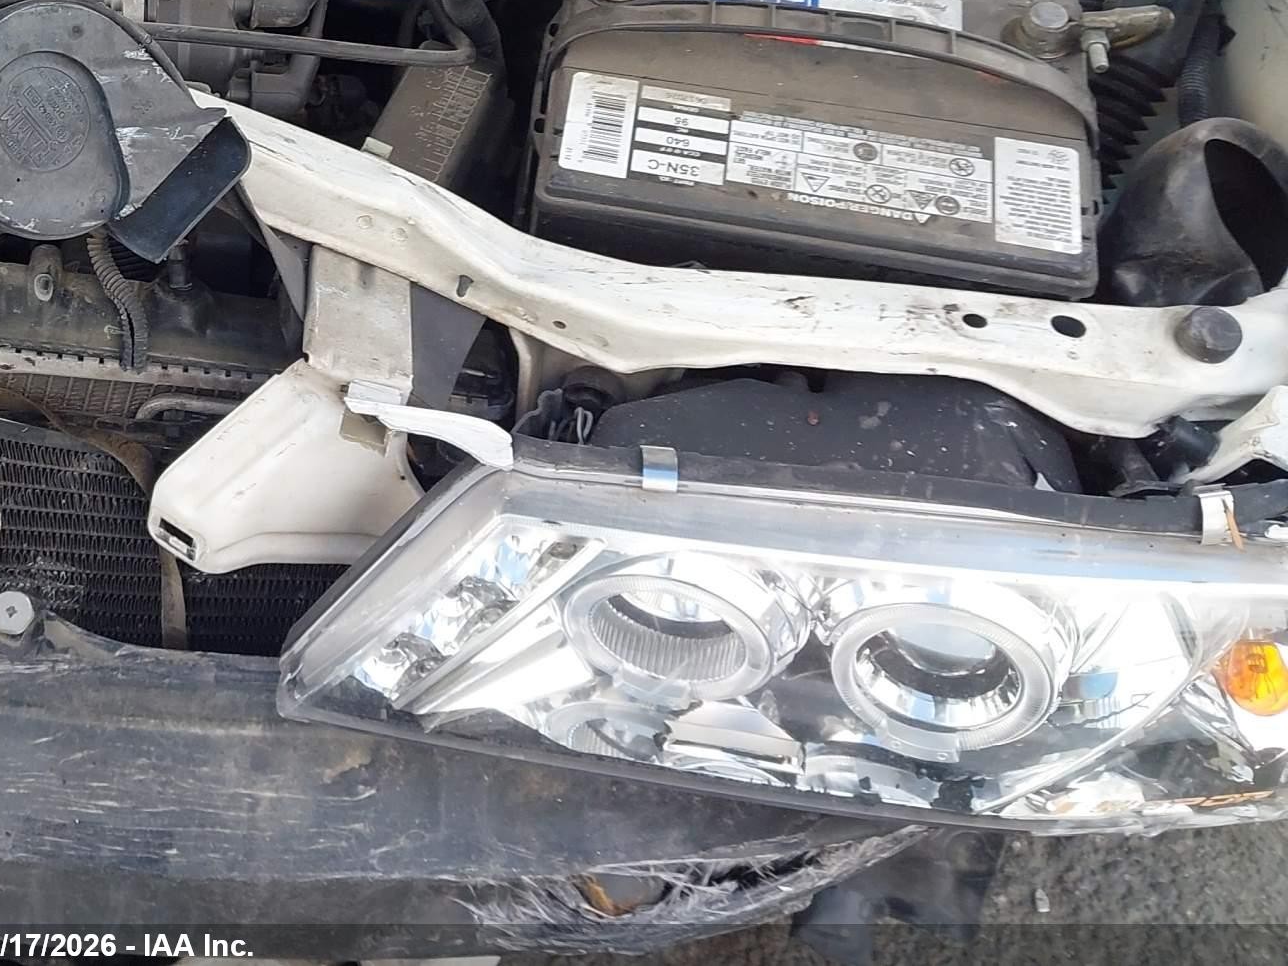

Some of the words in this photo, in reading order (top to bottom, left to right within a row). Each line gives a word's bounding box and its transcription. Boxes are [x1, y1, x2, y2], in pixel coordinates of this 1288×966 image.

[674, 116, 689, 126] 95
[666, 136, 690, 147] 640
[647, 159, 700, 177] 35N-C
